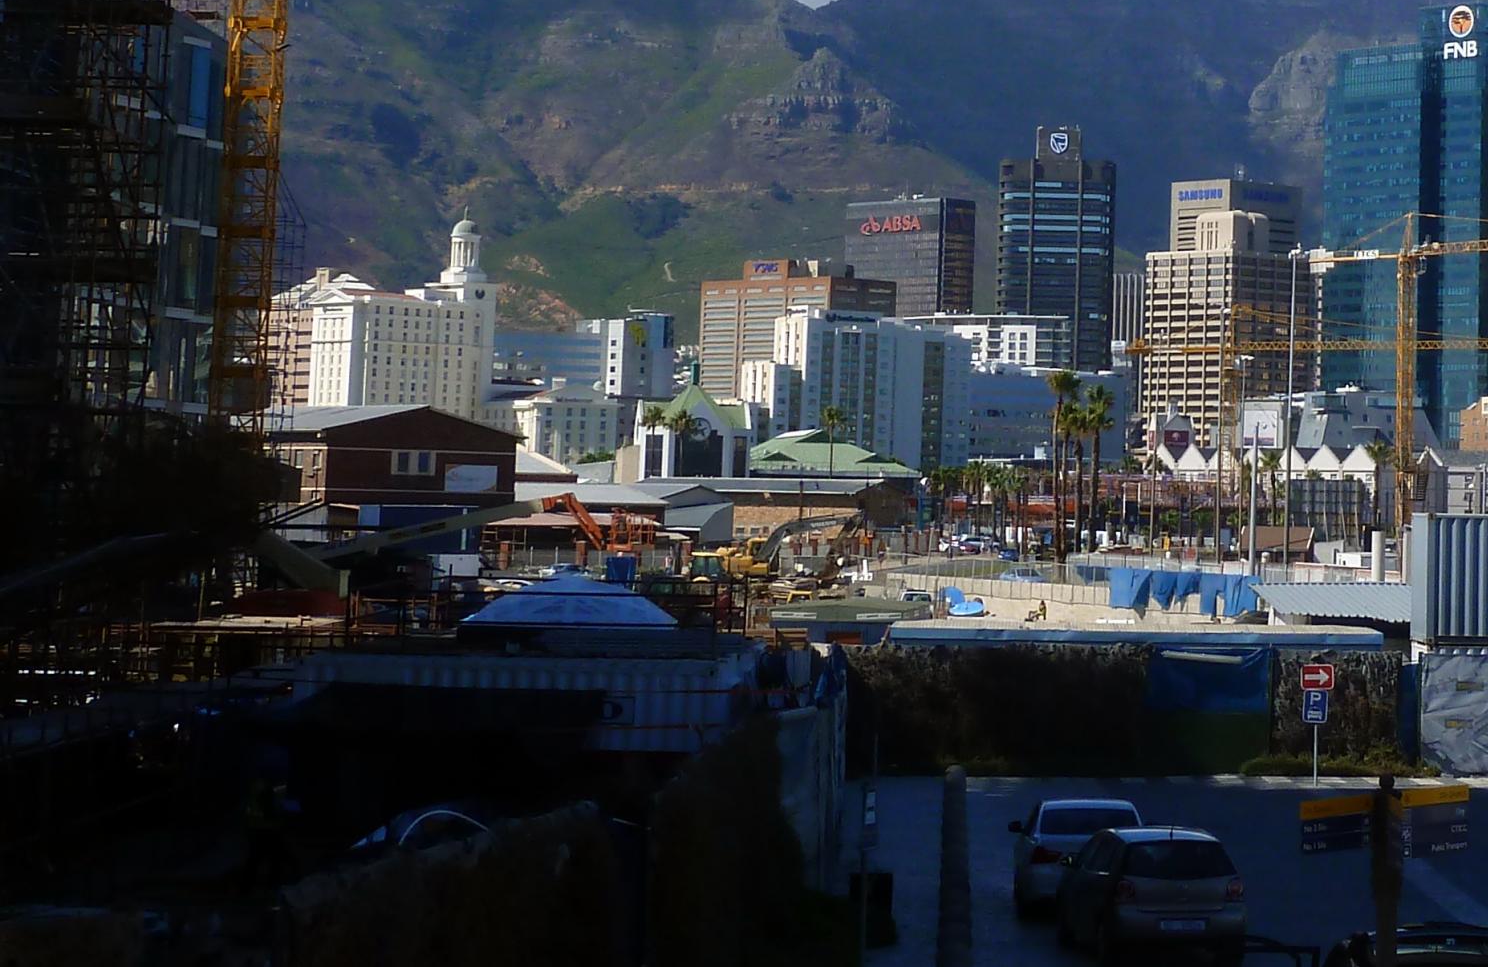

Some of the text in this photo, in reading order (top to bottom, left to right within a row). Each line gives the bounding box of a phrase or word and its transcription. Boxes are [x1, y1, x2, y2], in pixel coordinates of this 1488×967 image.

[1443, 40, 1478, 59] FNB
[1178, 188, 1223, 202] SAMSUNG
[881, 215, 921, 232] ABSA
[1310, 692, 1321, 705] P
